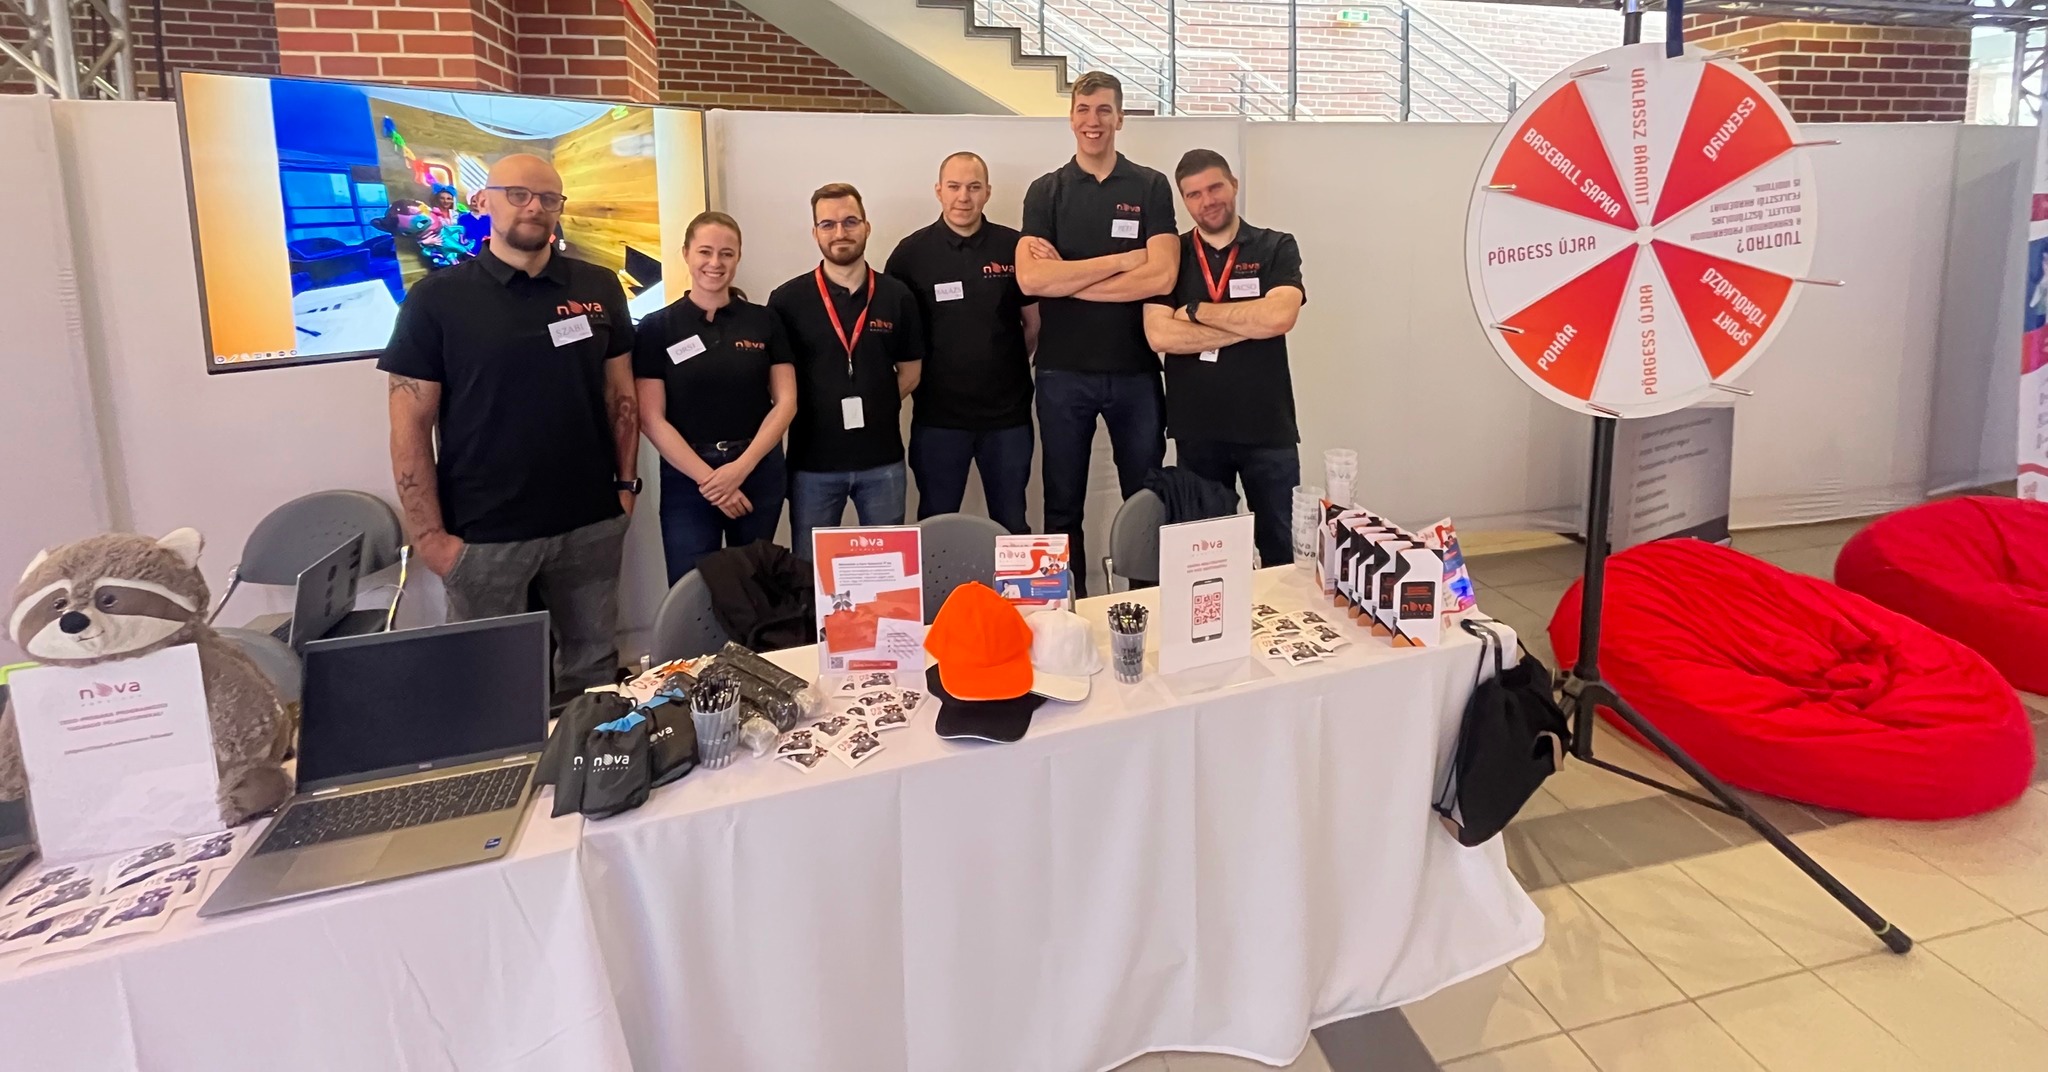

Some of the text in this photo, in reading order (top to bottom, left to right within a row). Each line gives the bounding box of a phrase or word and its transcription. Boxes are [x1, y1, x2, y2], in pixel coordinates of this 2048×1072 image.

[1702, 96, 1756, 162] ESERNYŐ
[1522, 127, 1622, 220] BASEBALL SAPKA
[1633, 145, 1649, 205] BÁRMIT
[1736, 230, 1802, 254] TUDTAD?
[1488, 235, 1596, 266] PÖRGESS ÚJRA
[983, 262, 1014, 273] nova
[557, 299, 602, 315] nova
[555, 323, 585, 337] SZABI
[1712, 310, 1752, 347] SPORT
[735, 340, 765, 350] nova
[1536, 323, 1578, 371] POHÁR
[1639, 284, 1658, 395] PÖRGESS ÚJRA
[850, 536, 884, 547] nova
[1192, 540, 1223, 551] nova
[1000, 550, 1026, 558] nova
[1401, 602, 1433, 612] nova
[79, 681, 141, 700] nova
[650, 727, 673, 742] ova
[594, 754, 630, 767] nova
